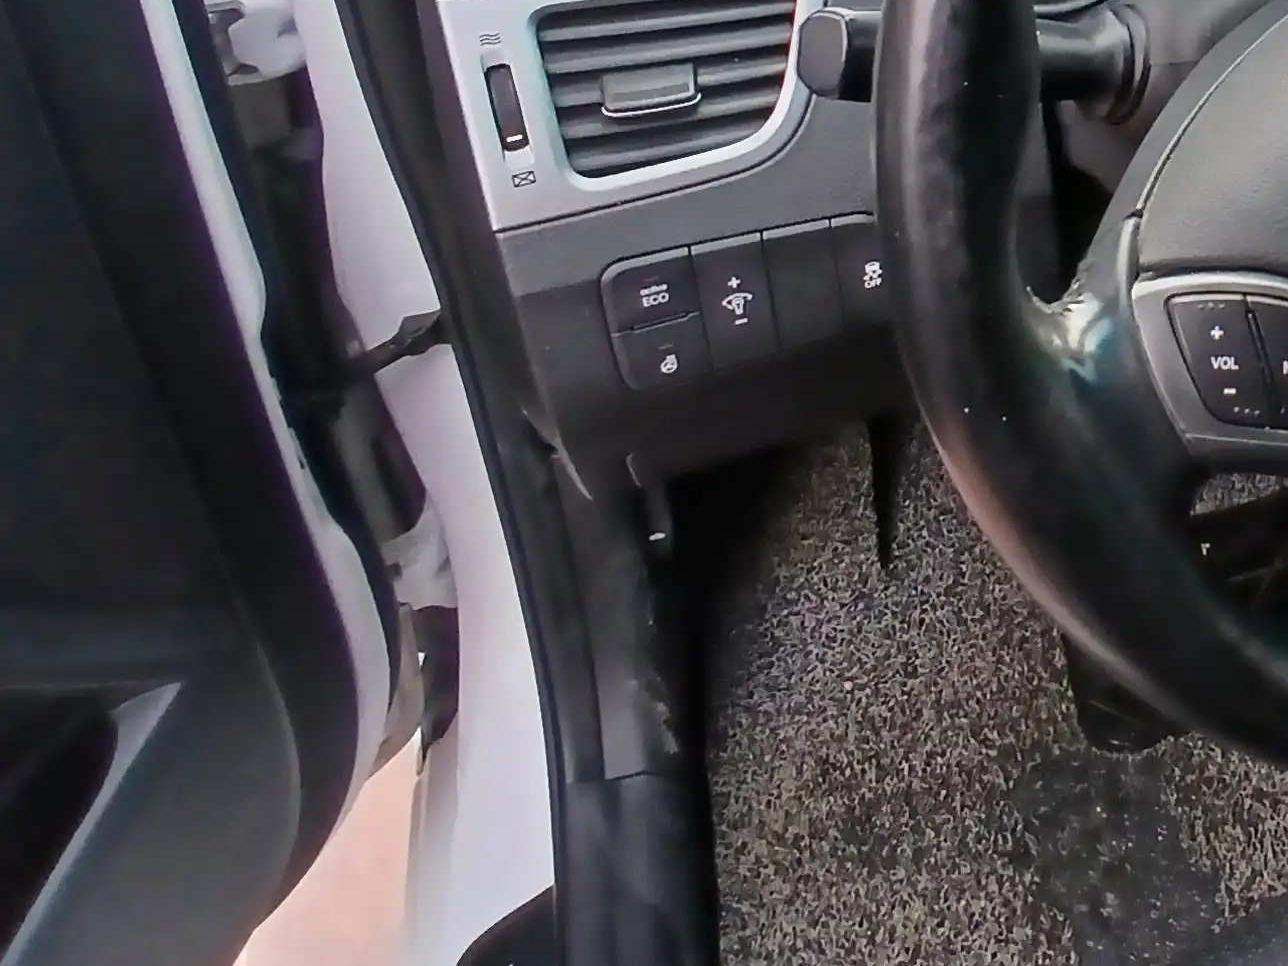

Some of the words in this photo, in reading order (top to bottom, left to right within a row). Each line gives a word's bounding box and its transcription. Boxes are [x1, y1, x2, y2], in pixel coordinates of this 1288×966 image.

[864, 277, 882, 289] OFF
[642, 292, 670, 307] ECO
[1210, 355, 1240, 371] VOL
